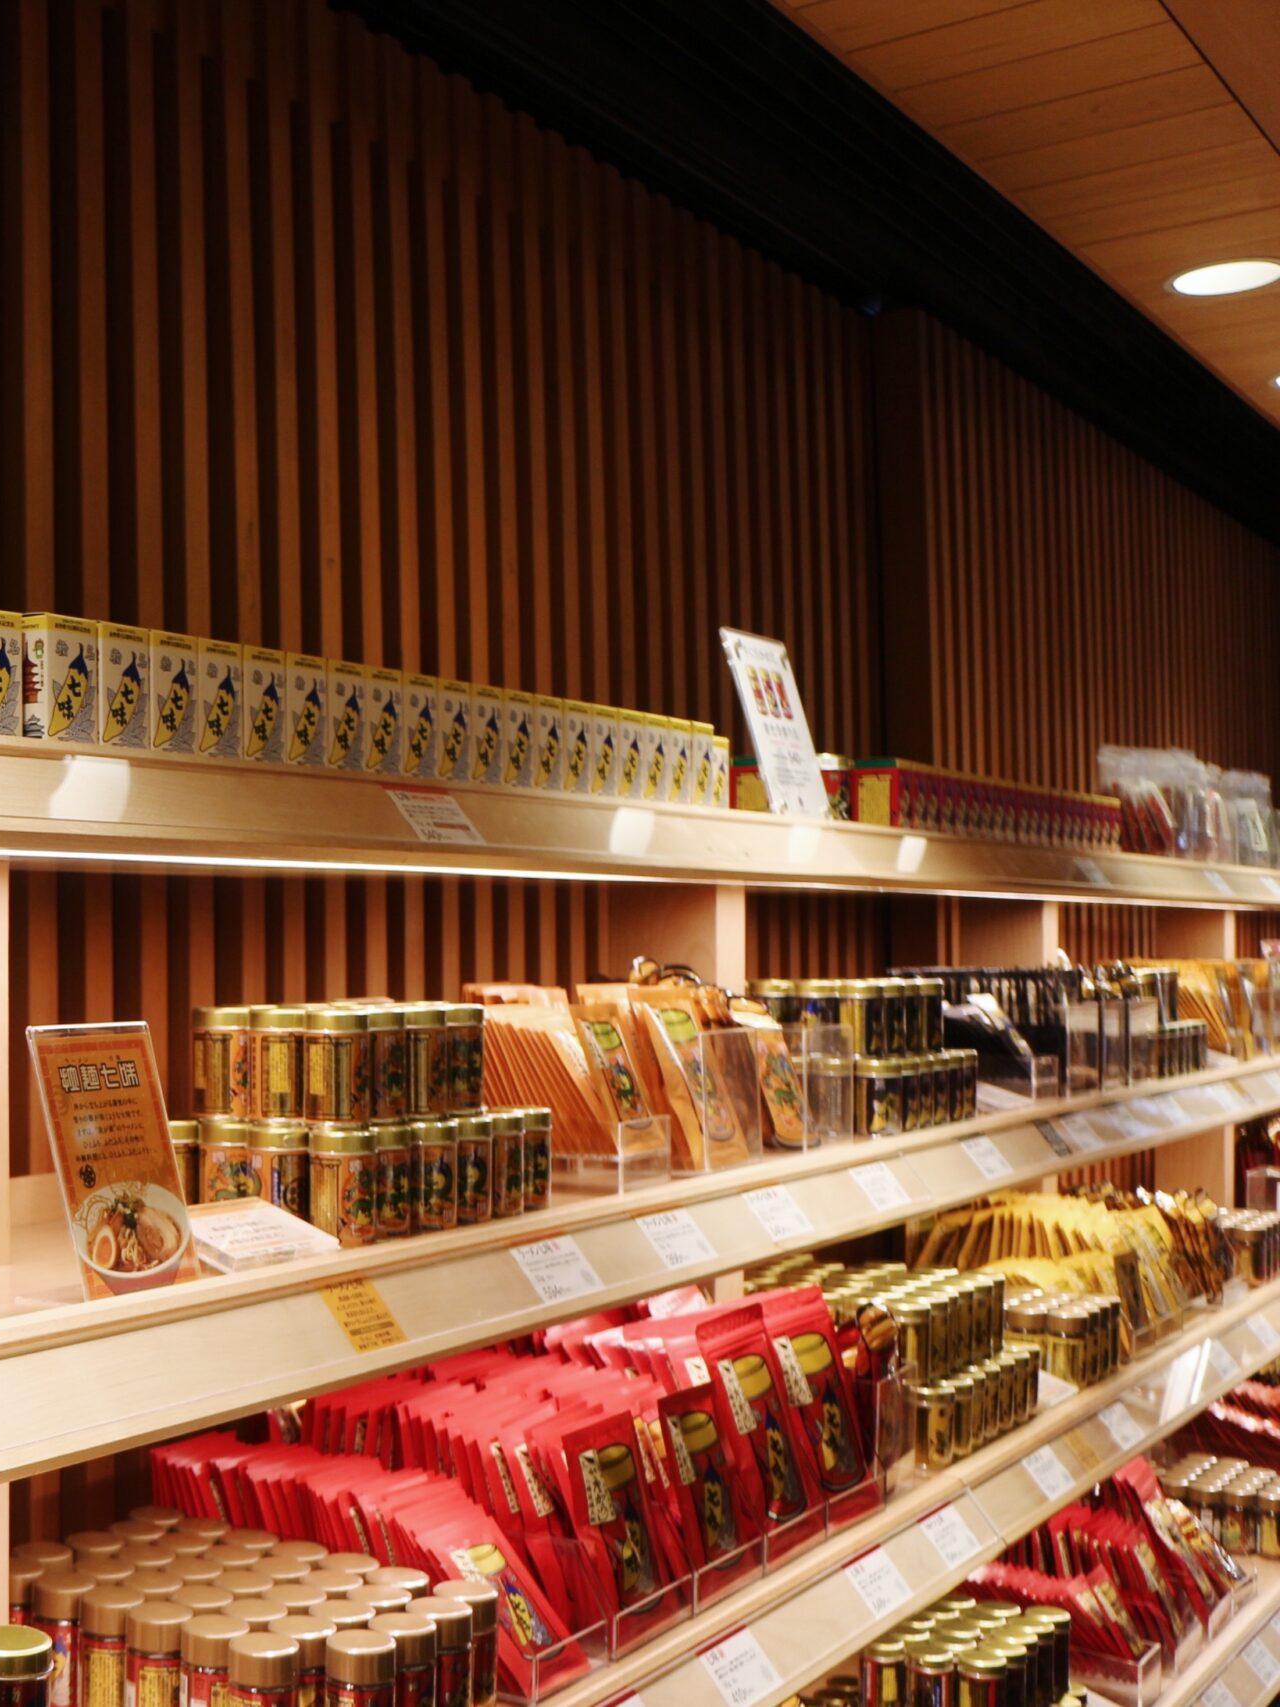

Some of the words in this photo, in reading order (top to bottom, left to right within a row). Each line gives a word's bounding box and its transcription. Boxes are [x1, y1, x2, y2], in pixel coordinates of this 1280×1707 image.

[57, 676, 81, 720] 七味
[112, 682, 134, 726] 七味
[162, 689, 183, 732] 七味
